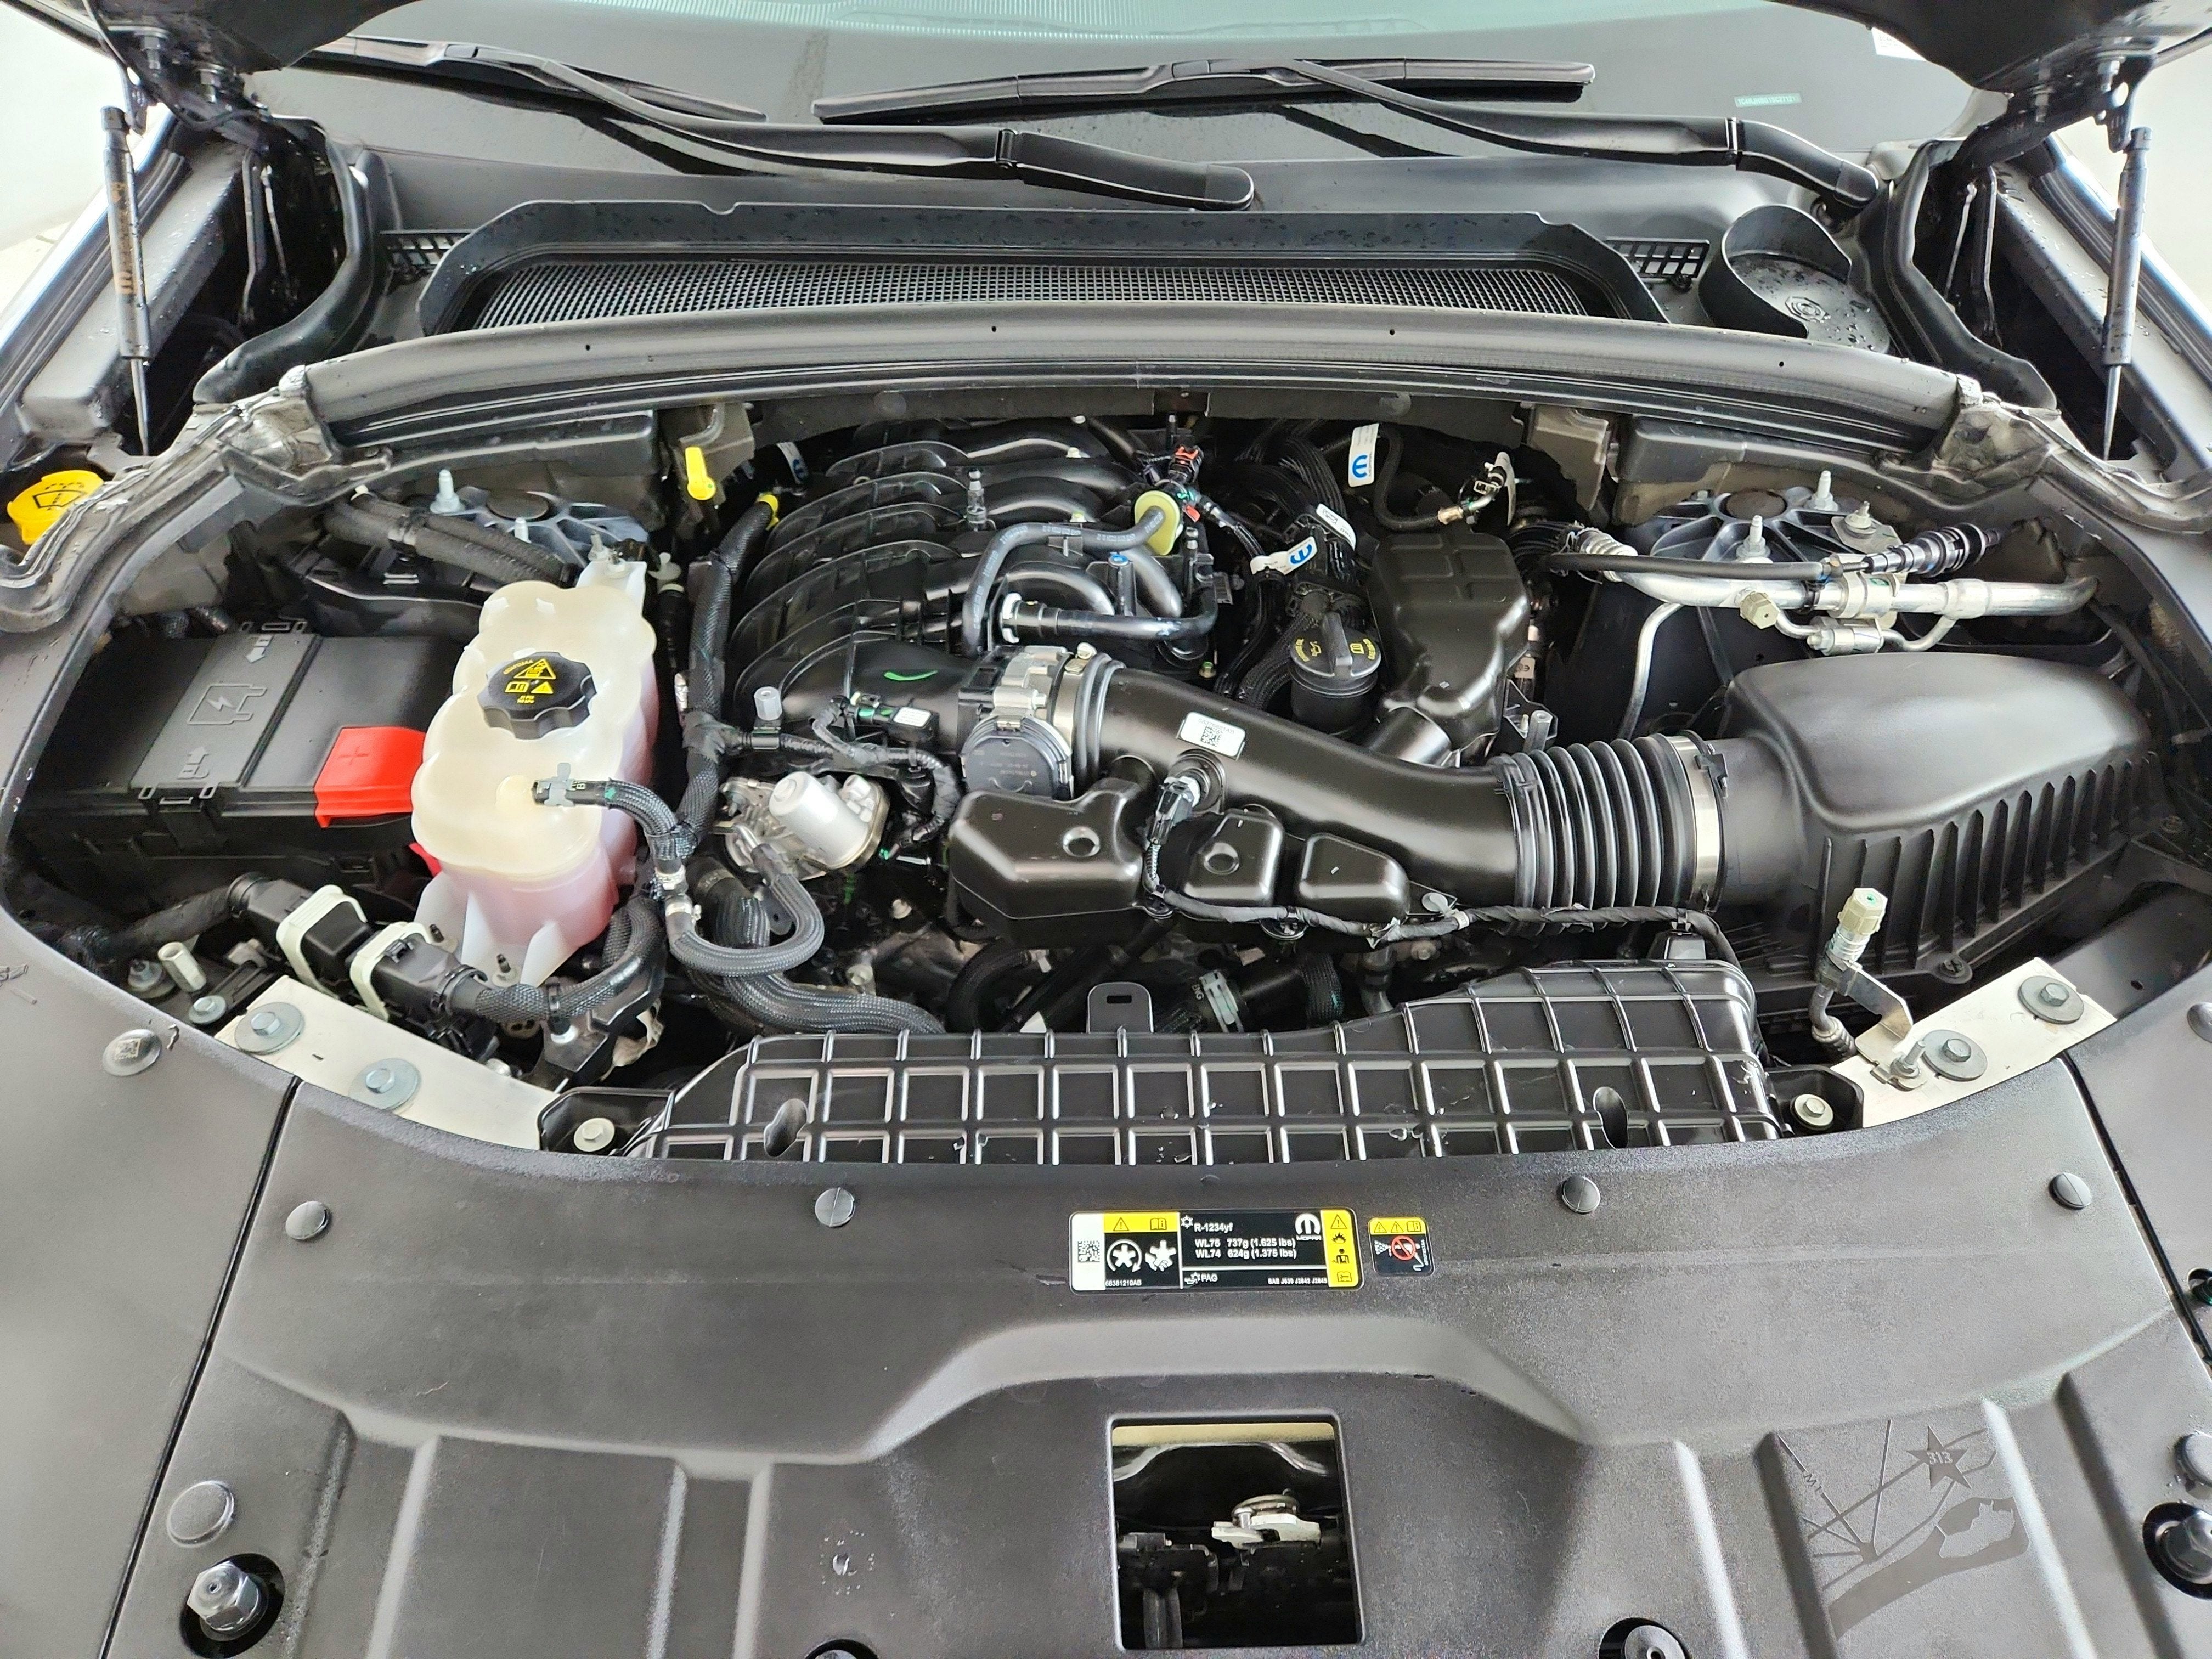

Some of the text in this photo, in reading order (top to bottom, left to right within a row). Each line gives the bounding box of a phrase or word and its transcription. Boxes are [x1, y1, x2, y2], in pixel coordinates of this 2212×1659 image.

[1194, 1222, 1234, 1233] R-1234yf
[1194, 1237, 1296, 1249] WL75 737g (1.625 lbs)
[1195, 1248, 1297, 1260] WL74 624g (1.375 lbs)
[1201, 1273, 1218, 1282] PAG
[1926, 1451, 1953, 1465] 313
